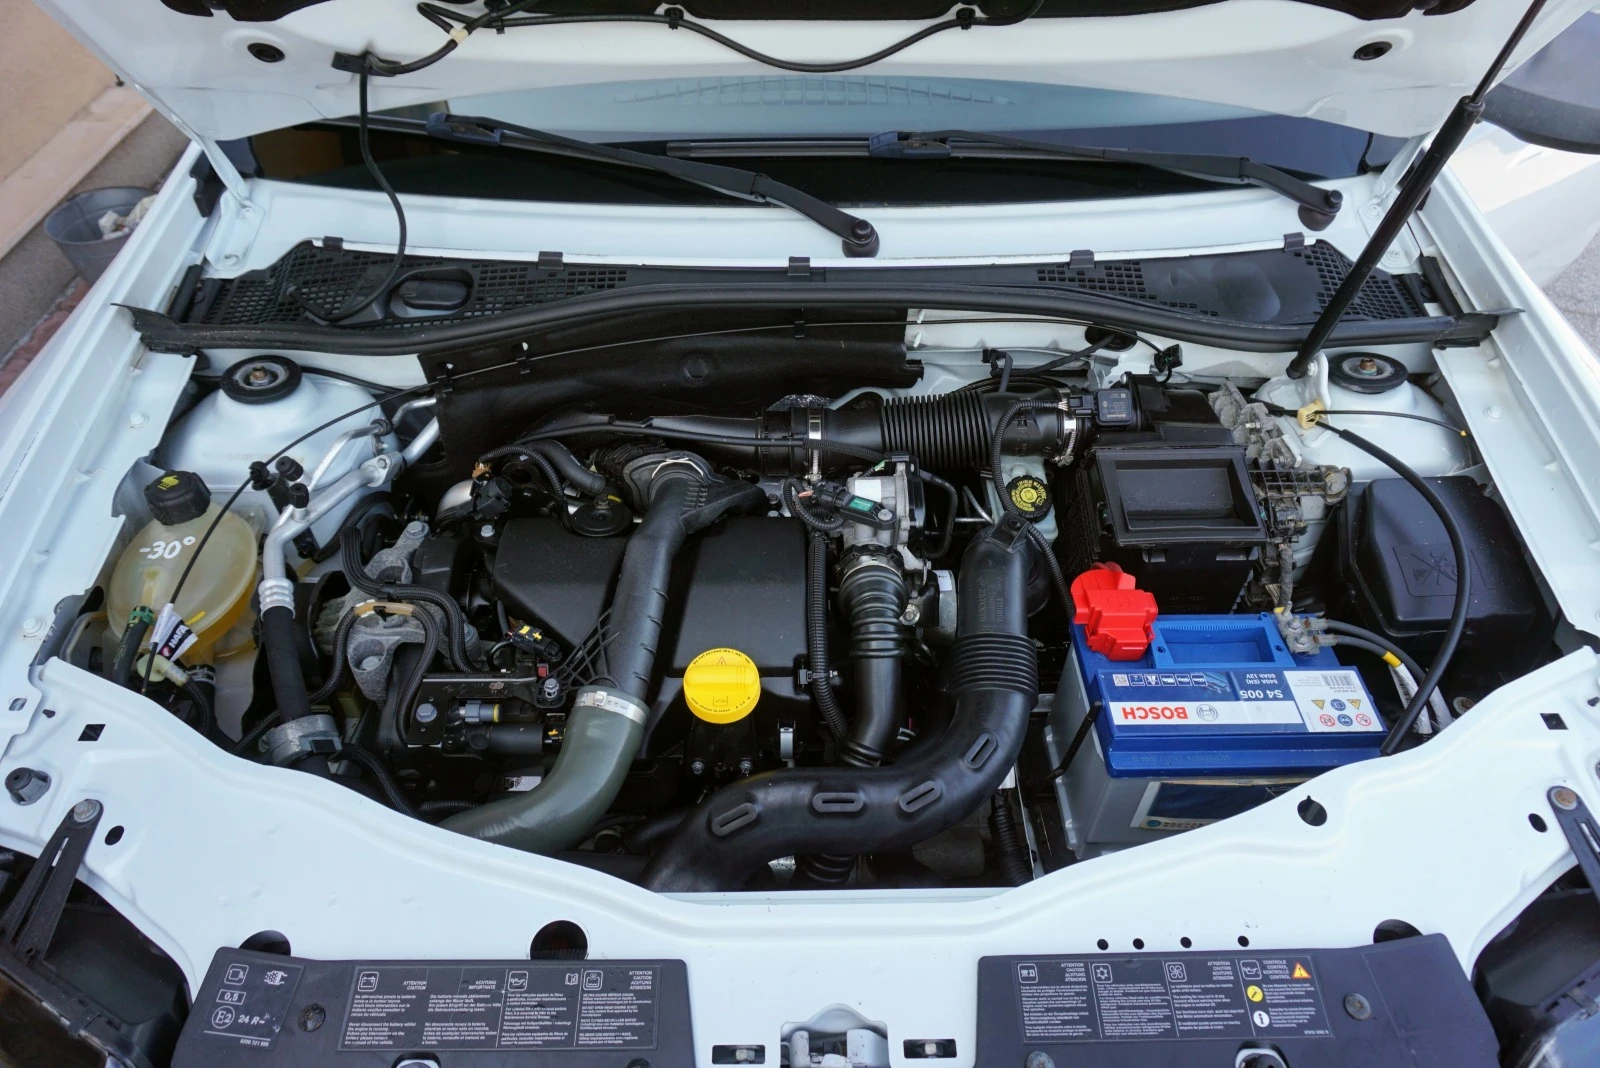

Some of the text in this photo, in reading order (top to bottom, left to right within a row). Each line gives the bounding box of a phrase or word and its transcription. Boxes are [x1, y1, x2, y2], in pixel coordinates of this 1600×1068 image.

[139, 536, 196, 559] -30°
[168, 624, 189, 648] HAFA
[1240, 690, 1284, 699] S4 005
[1122, 707, 1188, 720] BOSCH
[224, 992, 239, 1002] 0,5
[215, 1010, 232, 1024] E2
[238, 1014, 250, 1024] 24
